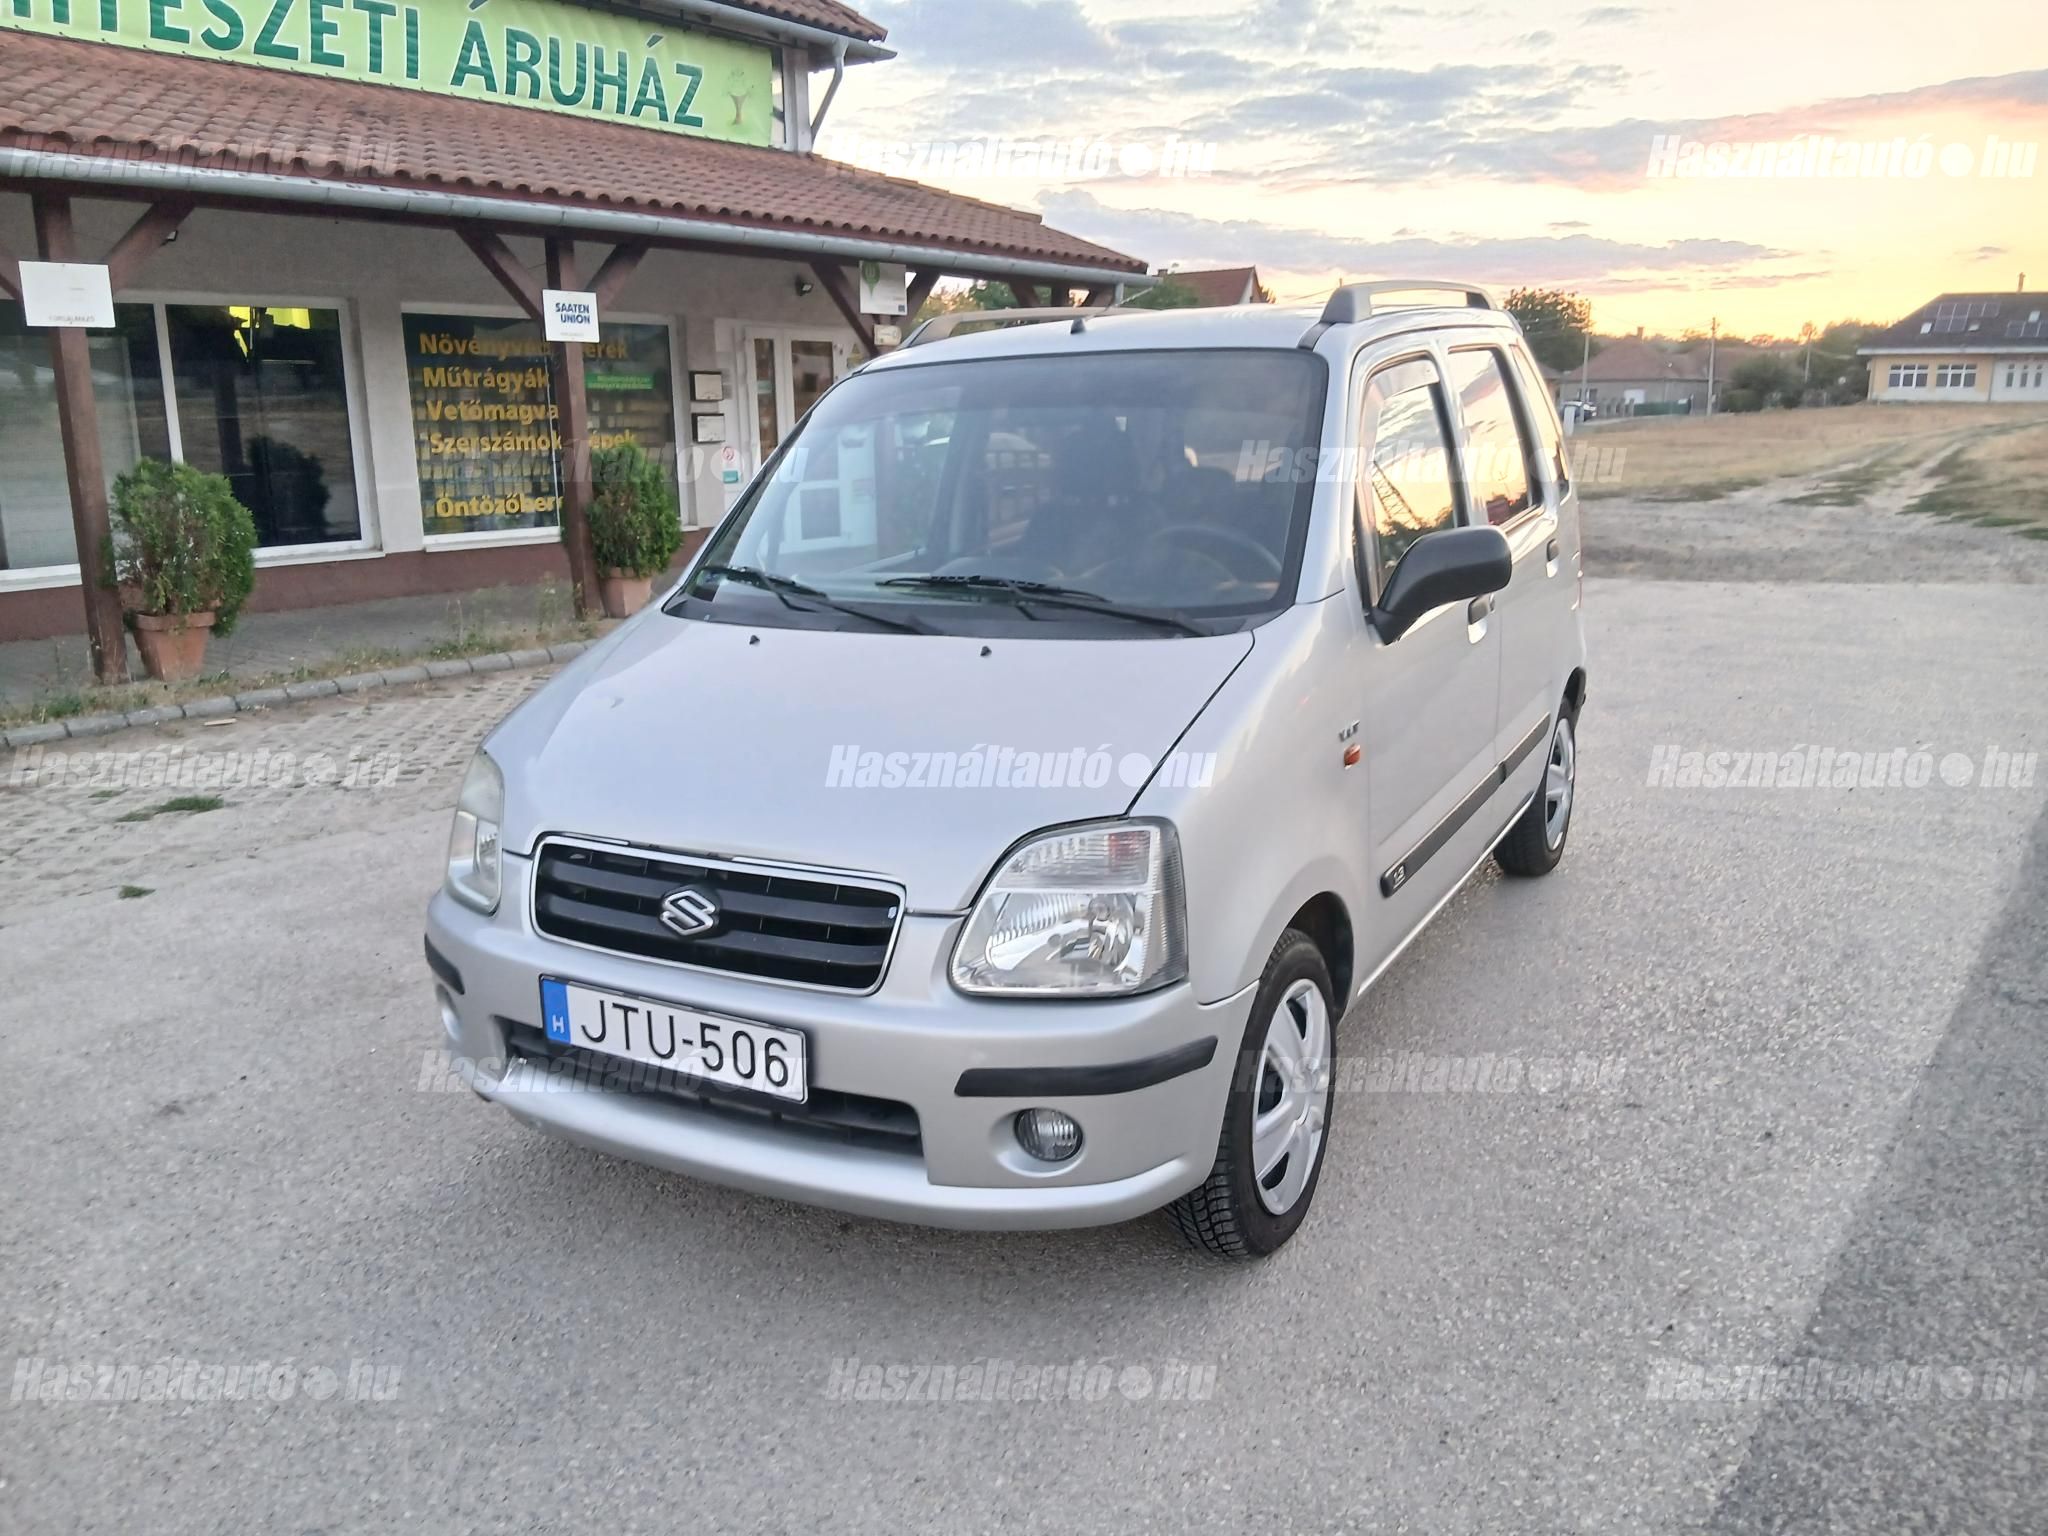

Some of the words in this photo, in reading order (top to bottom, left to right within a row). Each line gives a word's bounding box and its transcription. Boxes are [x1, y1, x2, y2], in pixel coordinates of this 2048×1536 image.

[450, 0, 704, 127] ÁRUHÁZ
[555, 302, 590, 314] SAATEN
[560, 313, 591, 325] UNION
[423, 366, 550, 394] Műtrágyák
[426, 399, 559, 425] Vetőmagva
[588, 429, 635, 449] épek
[436, 491, 564, 518] Öntözőber
[551, 1015, 565, 1034] H
[581, 999, 790, 1088] JTU-506
